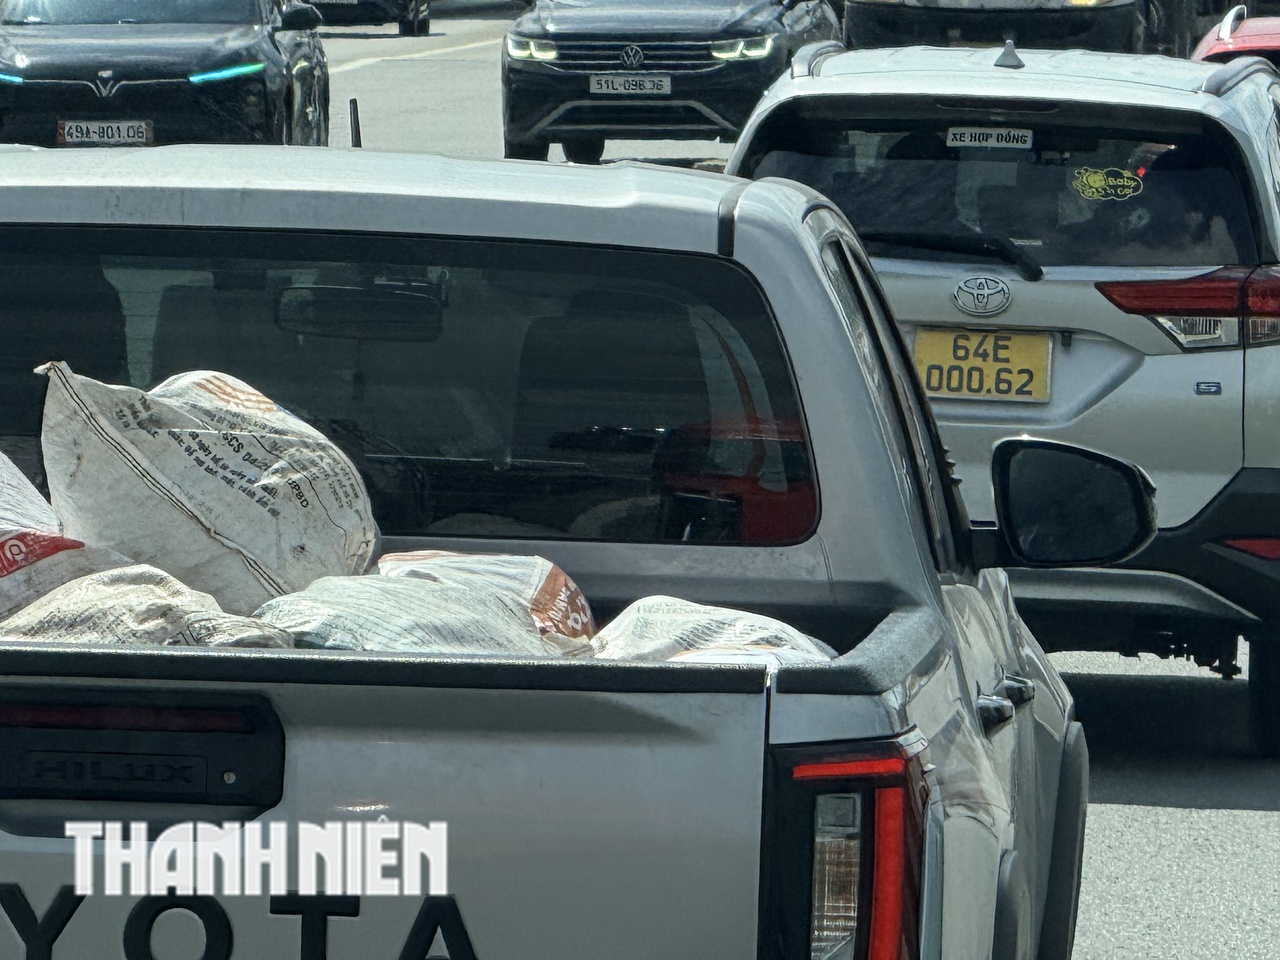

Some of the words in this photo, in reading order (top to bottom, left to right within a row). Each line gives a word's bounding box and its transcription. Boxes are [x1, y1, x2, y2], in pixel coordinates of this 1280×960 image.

[953, 333, 1012, 363] 64E
[925, 364, 1034, 396] 000.62
[35, 760, 195, 783] HILUX
